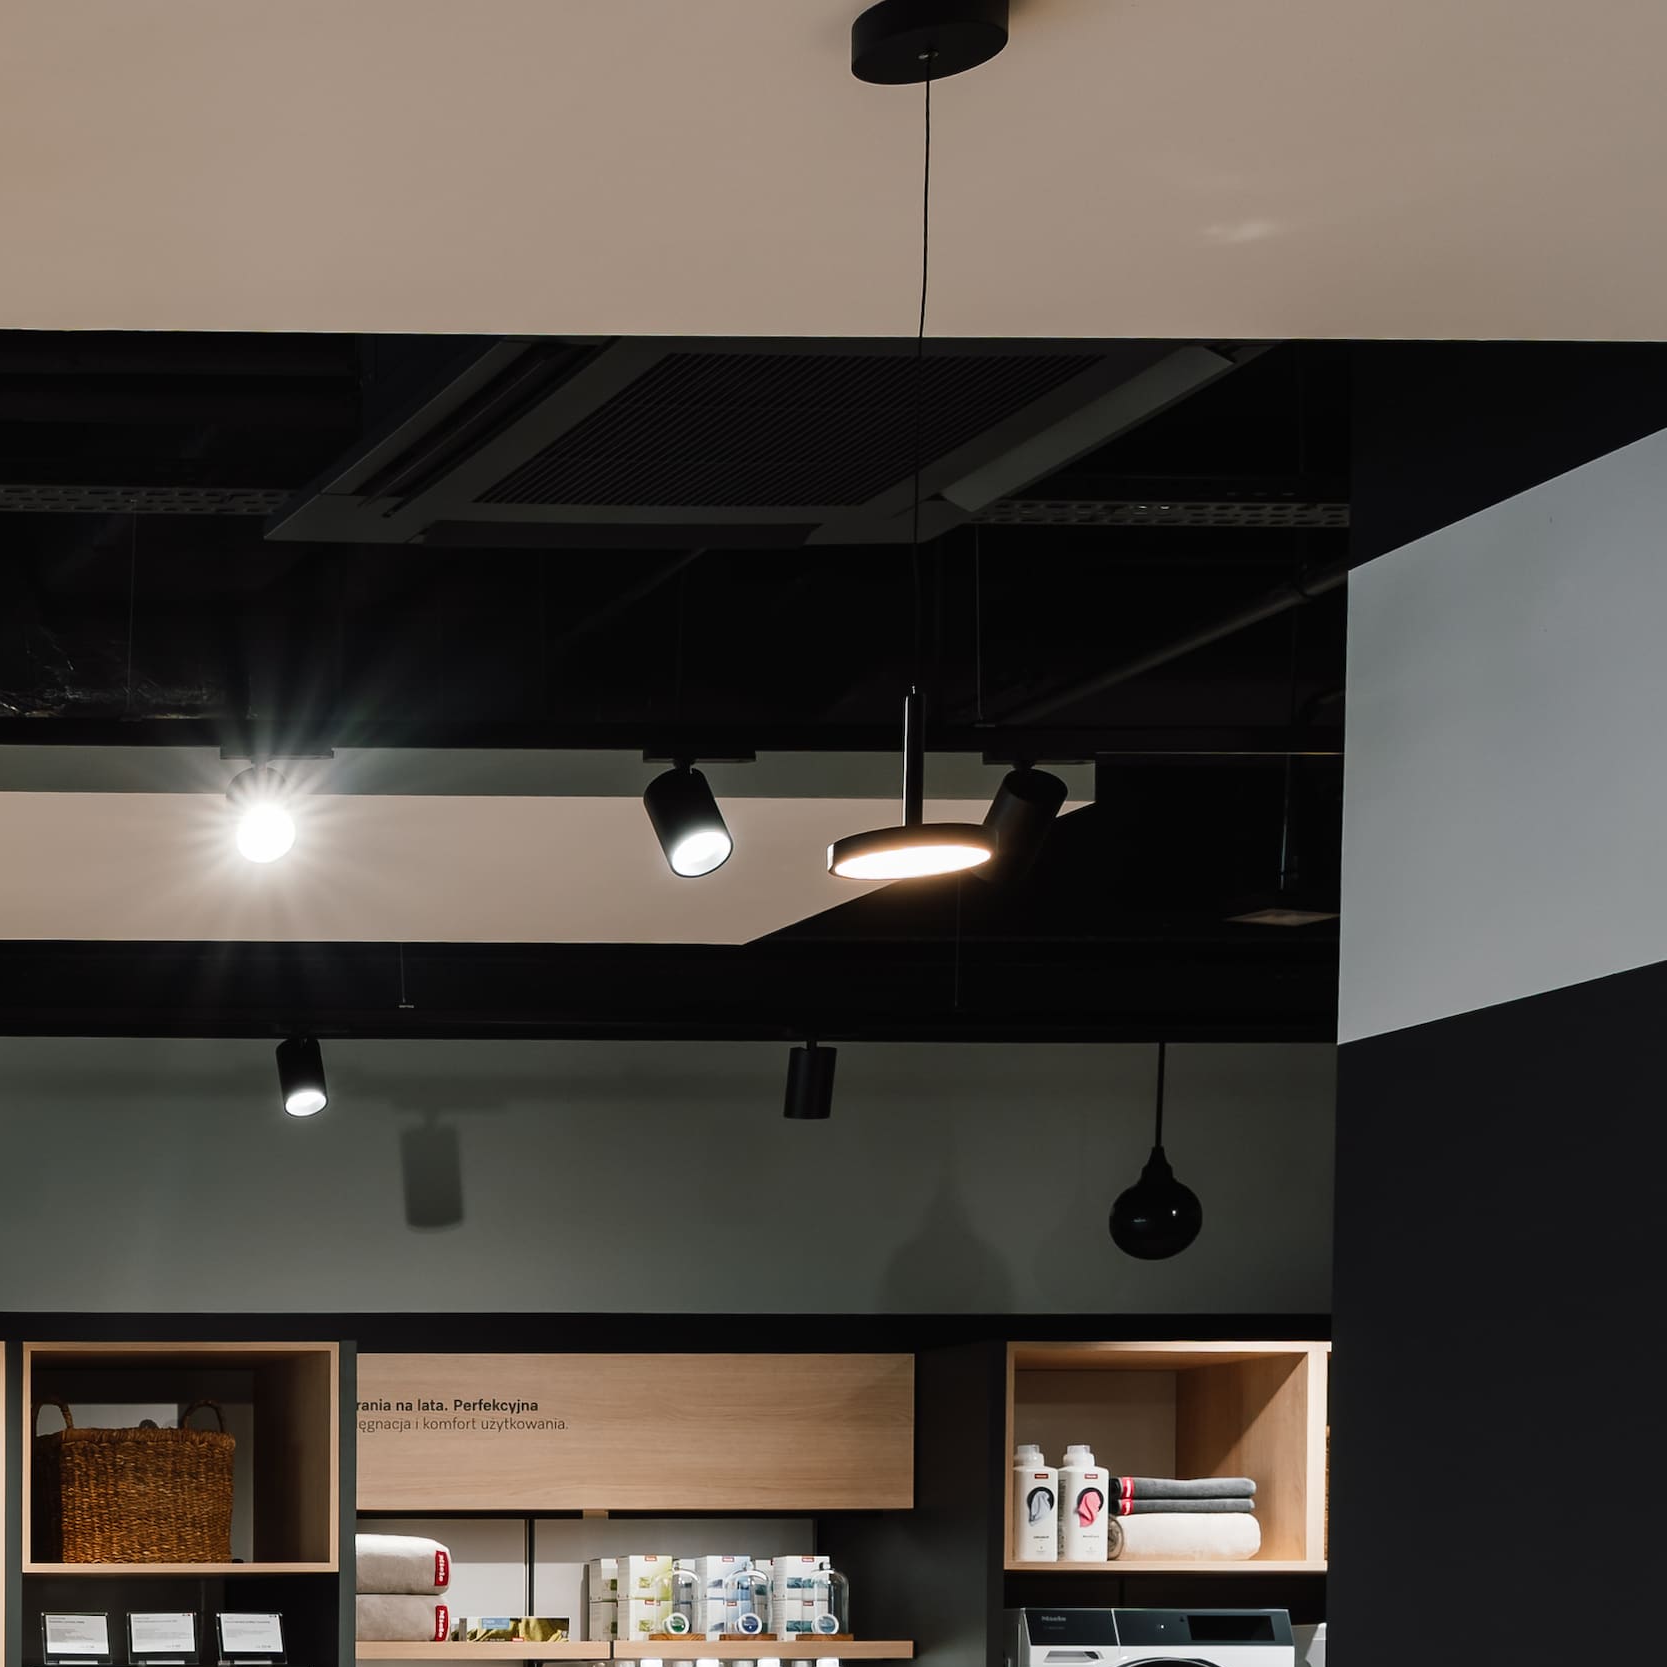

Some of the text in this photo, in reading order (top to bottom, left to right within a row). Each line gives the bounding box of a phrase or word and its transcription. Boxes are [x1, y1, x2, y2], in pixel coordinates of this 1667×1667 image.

[357, 1399, 539, 1414] rania na lata. Perfekcyjna
[416, 1418, 569, 1433] i komfort użytkowania.
